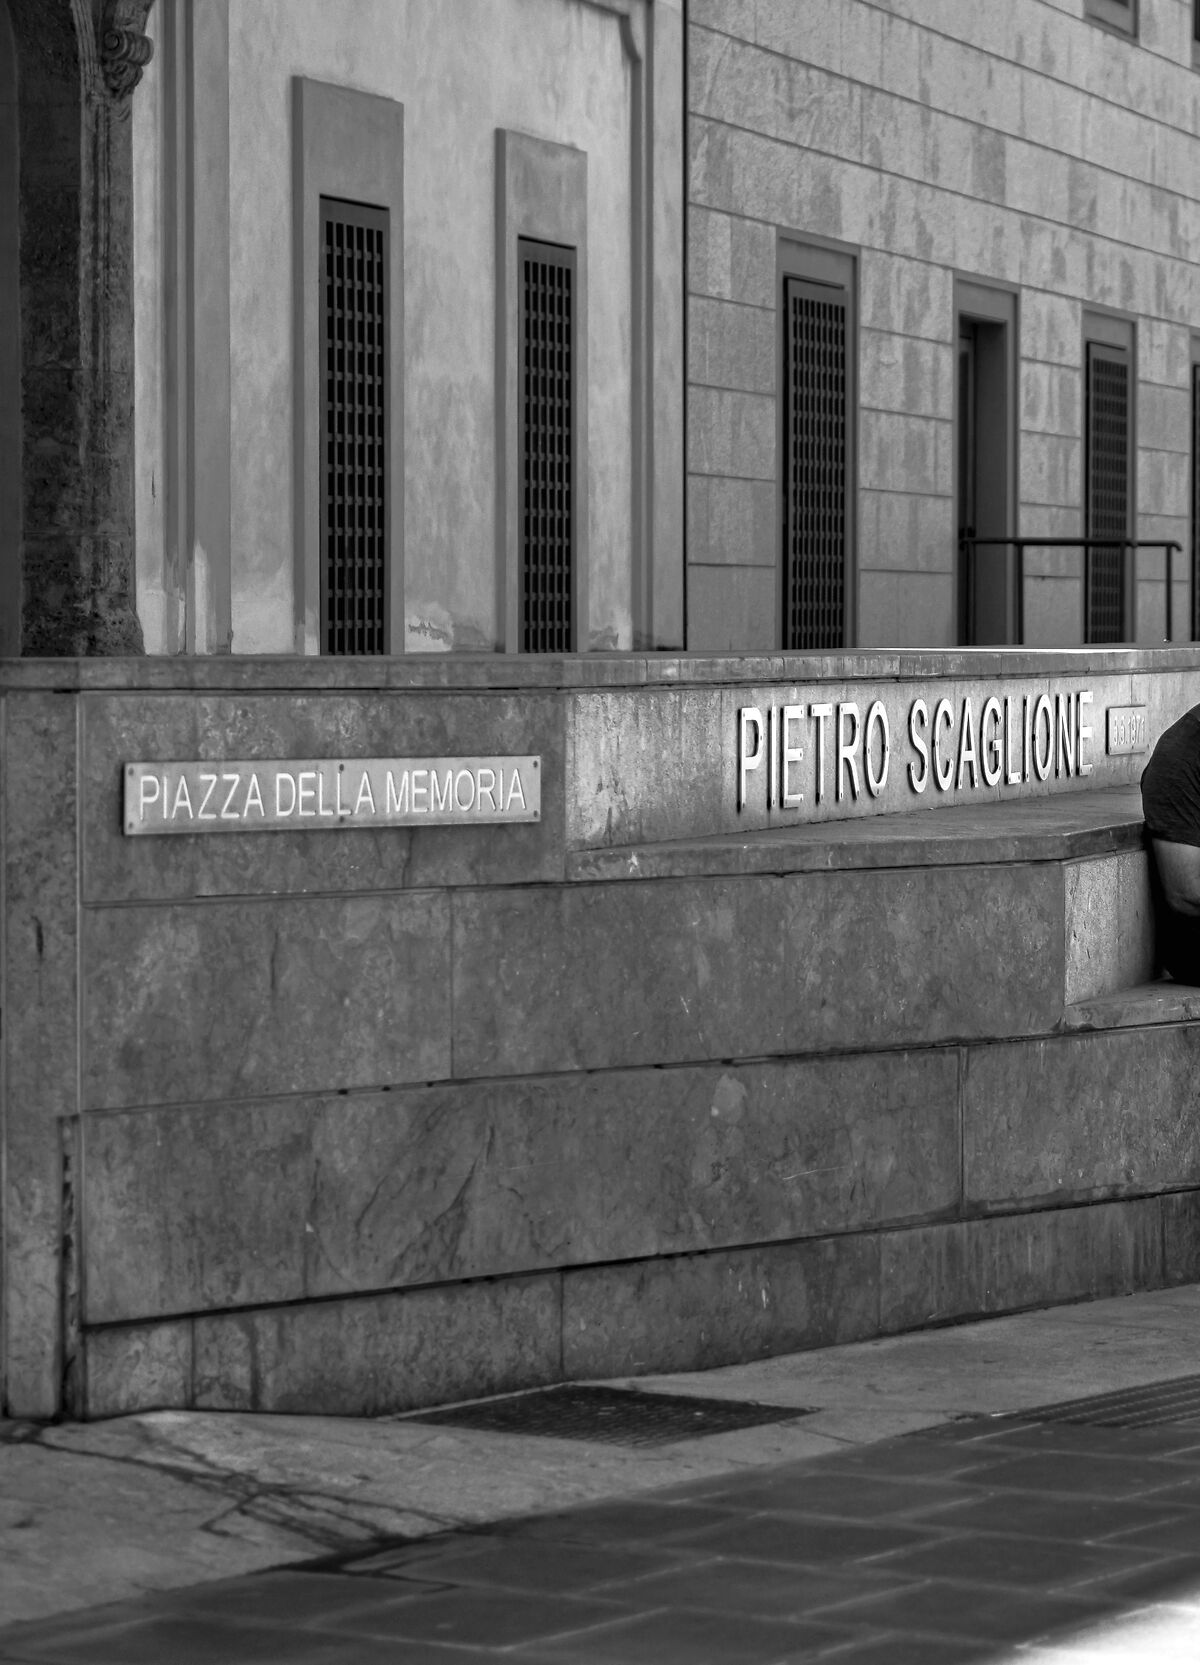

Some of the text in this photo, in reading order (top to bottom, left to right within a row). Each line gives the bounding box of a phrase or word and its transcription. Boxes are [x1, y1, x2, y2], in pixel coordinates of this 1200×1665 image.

[139, 767, 527, 821] PIAZZA DELLA MEMORIA
[738, 690, 1094, 811] PIETRO SCAGLIONE
